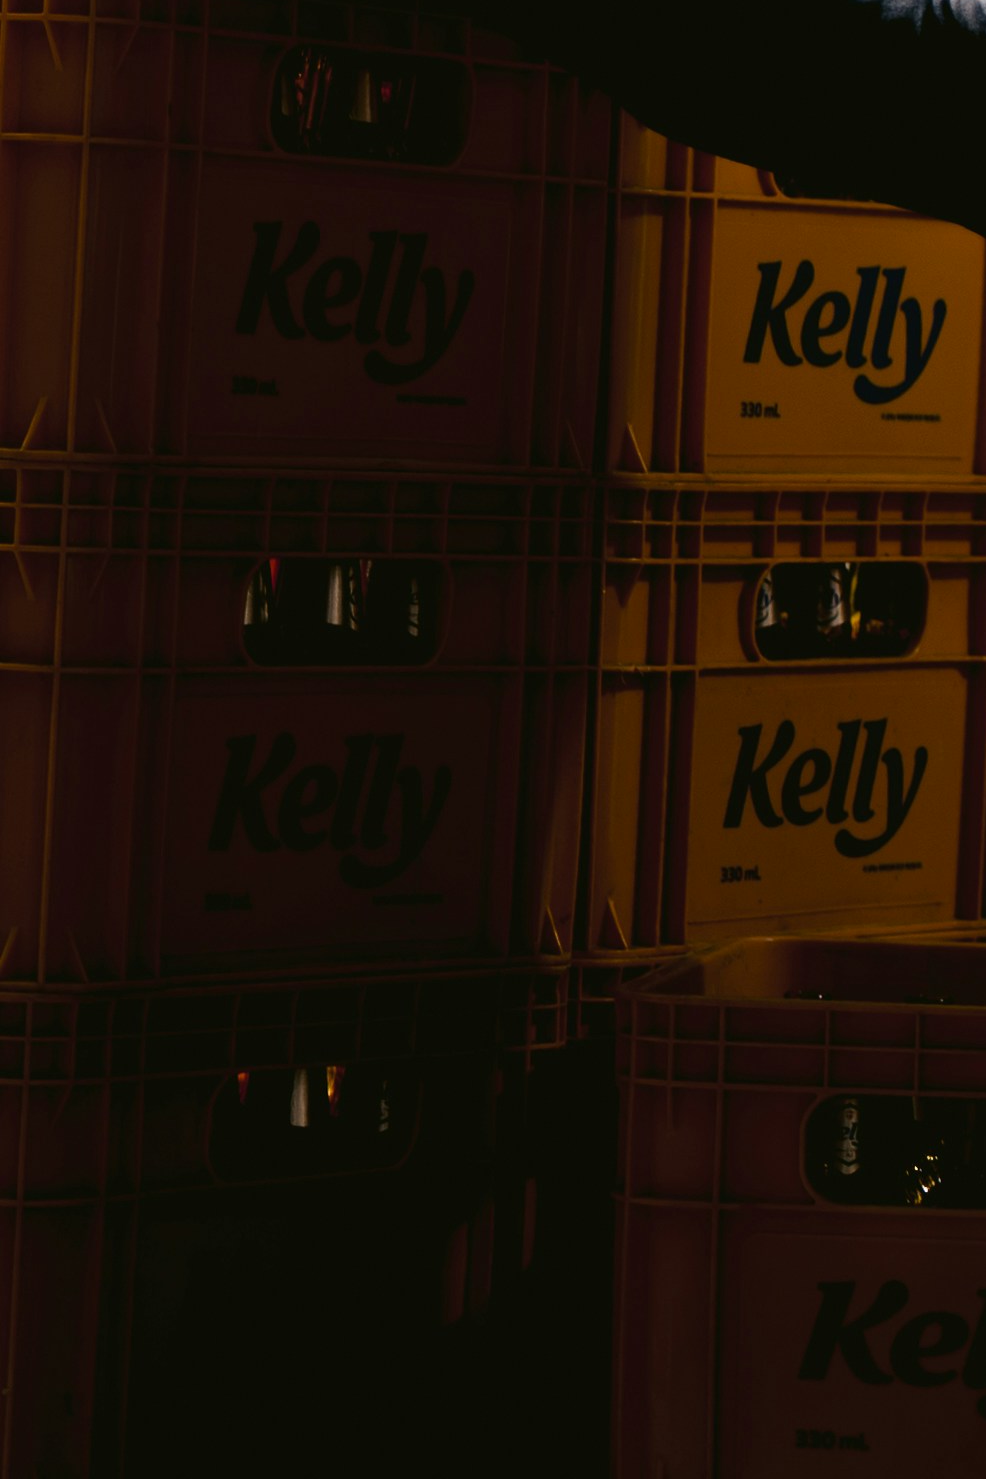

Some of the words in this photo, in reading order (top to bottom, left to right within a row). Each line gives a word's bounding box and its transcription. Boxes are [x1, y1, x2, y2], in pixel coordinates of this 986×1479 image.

[235, 221, 475, 386] Kelly
[742, 259, 947, 404] Kelly
[740, 401, 762, 418] 330
[207, 731, 453, 890] Kelly
[722, 718, 928, 858] Kelly
[720, 865, 743, 883] 330
